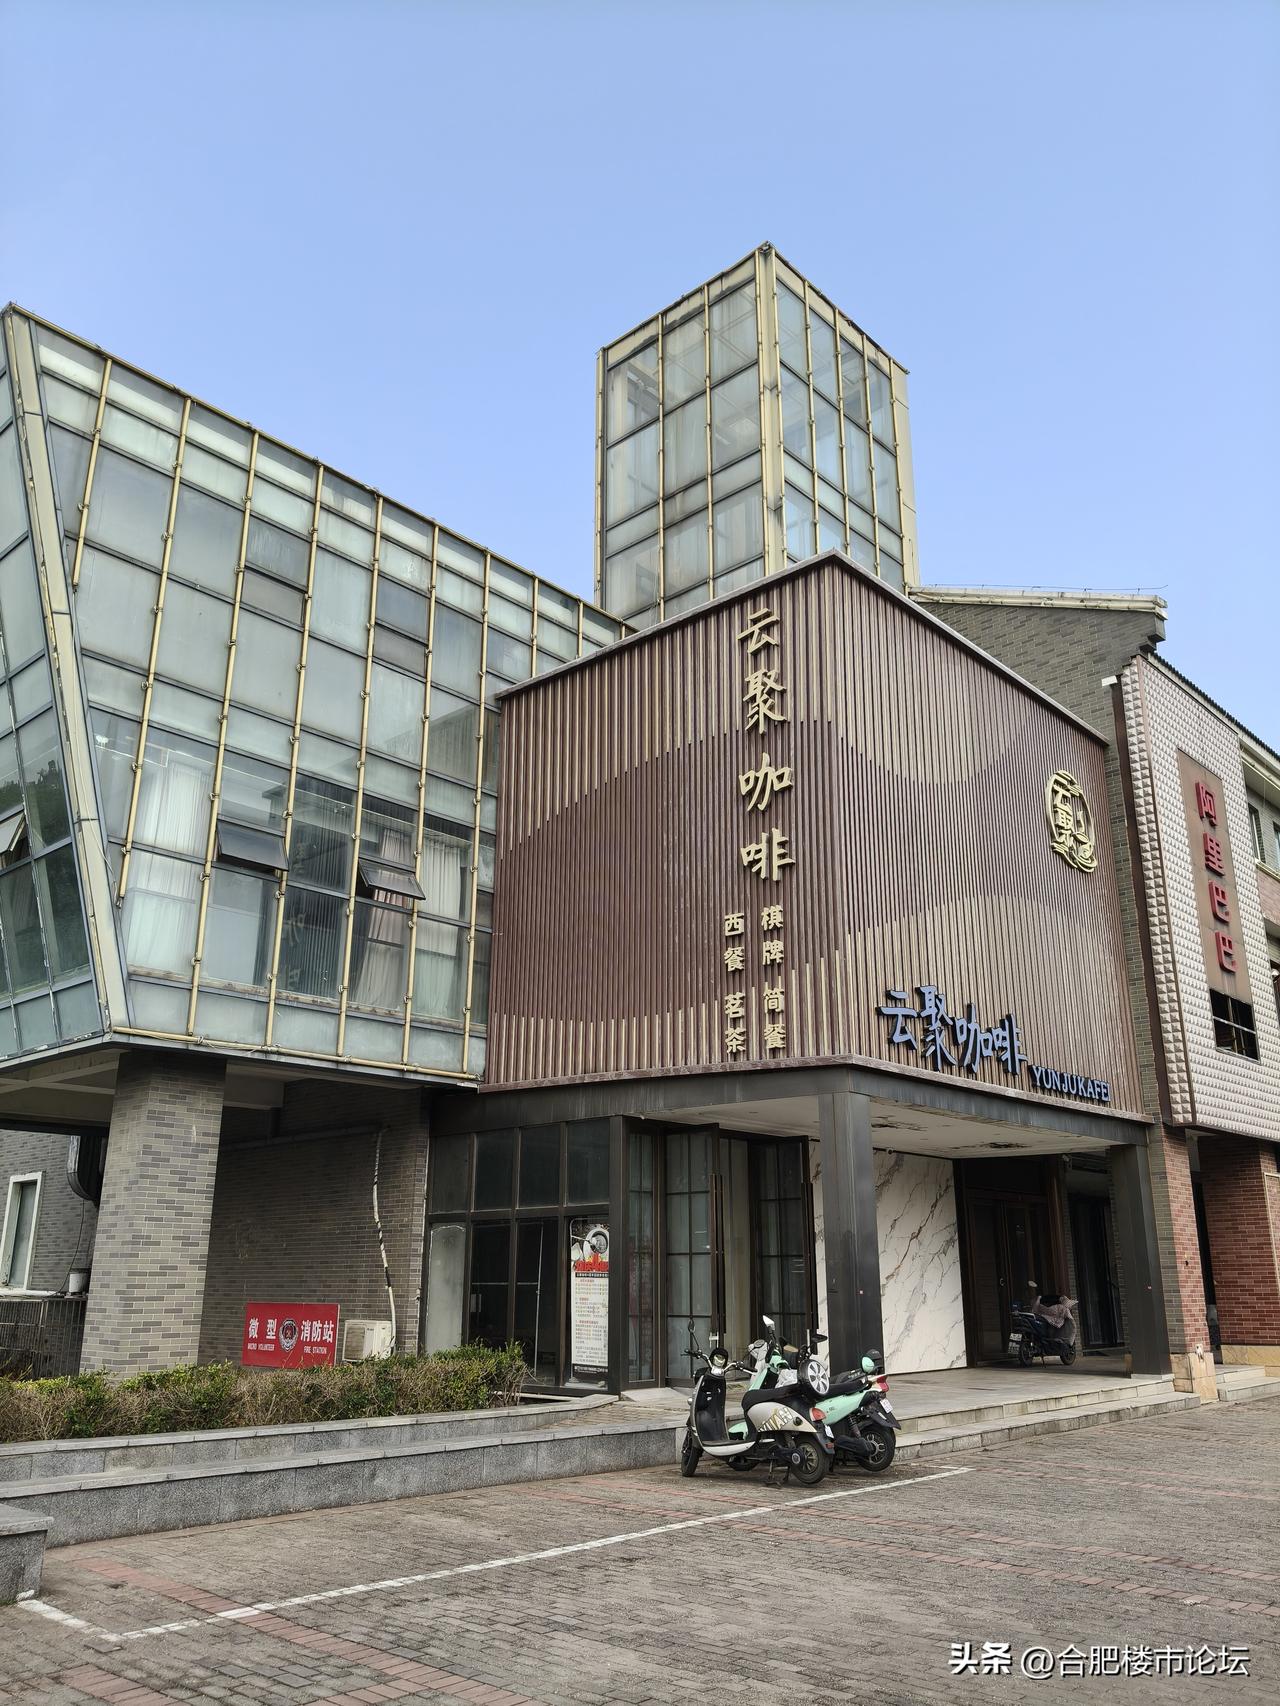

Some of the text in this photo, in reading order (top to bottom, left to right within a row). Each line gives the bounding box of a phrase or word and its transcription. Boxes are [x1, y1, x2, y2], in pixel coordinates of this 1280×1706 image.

[737, 608, 796, 881] 云聚咖啡
[1195, 782, 1237, 973] 阿里巴巴
[877, 985, 1029, 1075] 云聚咖啡
[300, 1319, 334, 1343] 消防站
